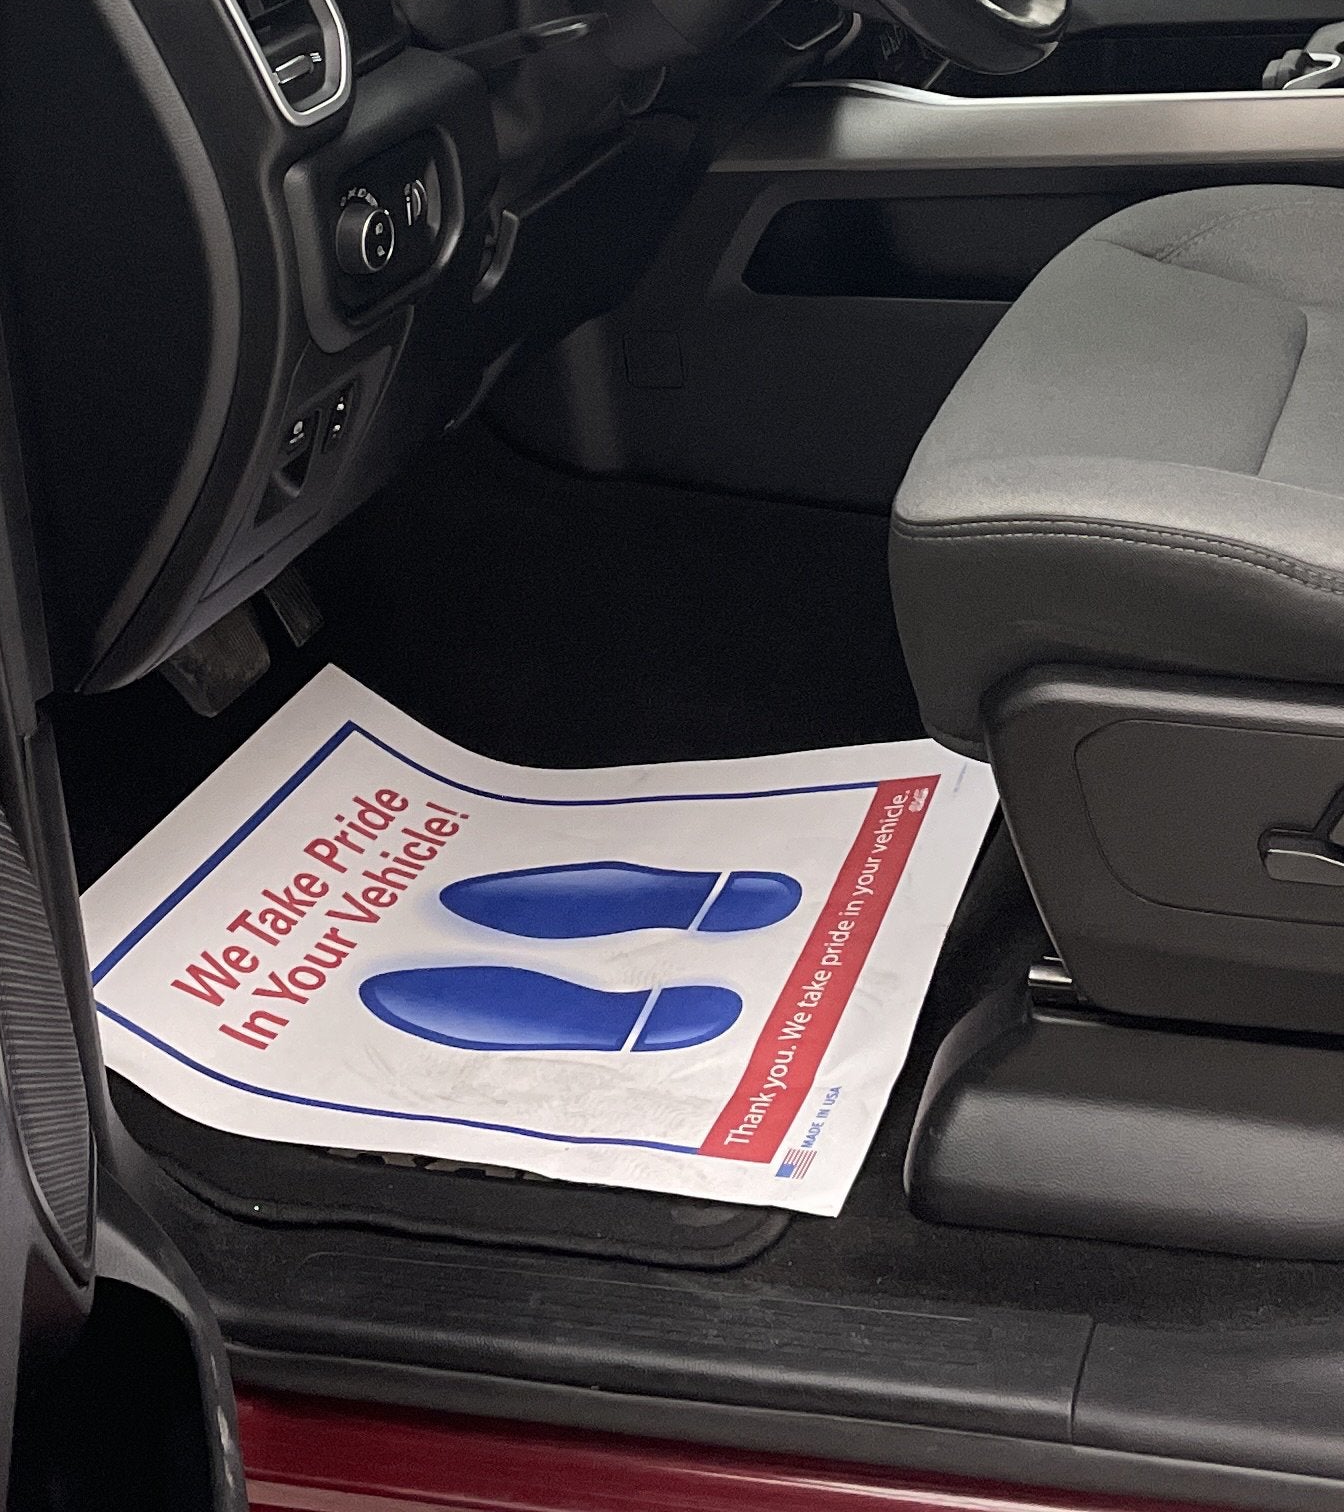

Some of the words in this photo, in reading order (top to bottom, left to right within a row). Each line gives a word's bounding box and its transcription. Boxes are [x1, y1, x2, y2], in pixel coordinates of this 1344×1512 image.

[871, 788, 912, 855] vehicle.
[324, 801, 470, 924] Vehicle!
[852, 855, 883, 896] your
[170, 945, 260, 1007] We
[226, 872, 330, 947] Take
[303, 788, 409, 874] Pride
[838, 899, 865, 917] in
[251, 926, 358, 1004] Your
[820, 919, 856, 967] pride
[797, 969, 833, 1009] take
[218, 1010, 290, 1050] In
[778, 1011, 813, 1041] We
[763, 1044, 798, 1090] you.
[723, 1091, 777, 1146] Thank
[801, 1120, 825, 1149] MADE
[815, 1105, 832, 1120] IN
[824, 1085, 843, 1106] USA
